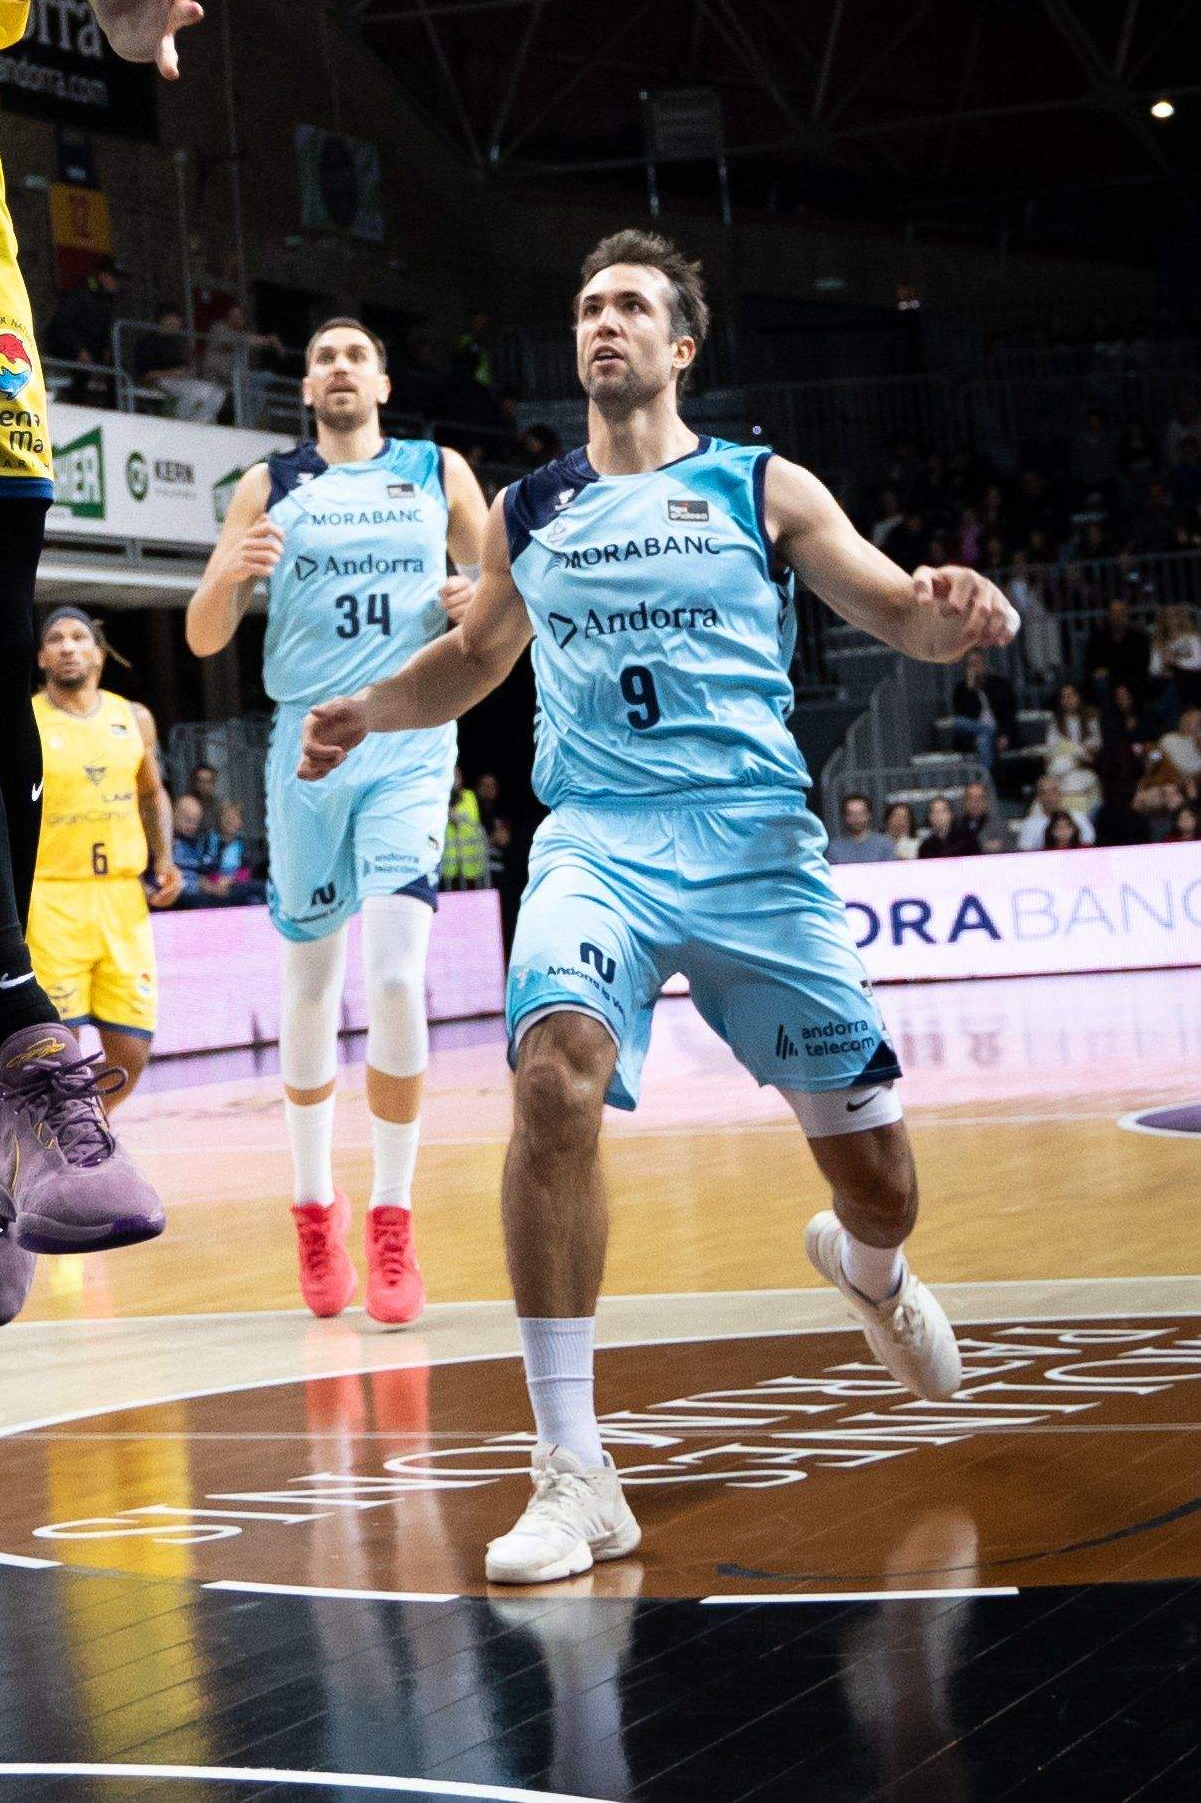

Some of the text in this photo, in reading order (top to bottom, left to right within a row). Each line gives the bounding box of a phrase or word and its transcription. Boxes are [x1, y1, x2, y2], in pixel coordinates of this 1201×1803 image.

[9, 430, 45, 455] Ma
[311, 509, 424, 526] MORABANC
[323, 553, 424, 576] Andorra
[564, 536, 721, 570] MORABANC
[334, 593, 392, 640] 34
[584, 600, 719, 639] Andorra
[619, 664, 661, 731] 9
[91, 842, 109, 877] 6
[801, 1019, 869, 1039] andorra
[805, 1036, 875, 1057] telecom
